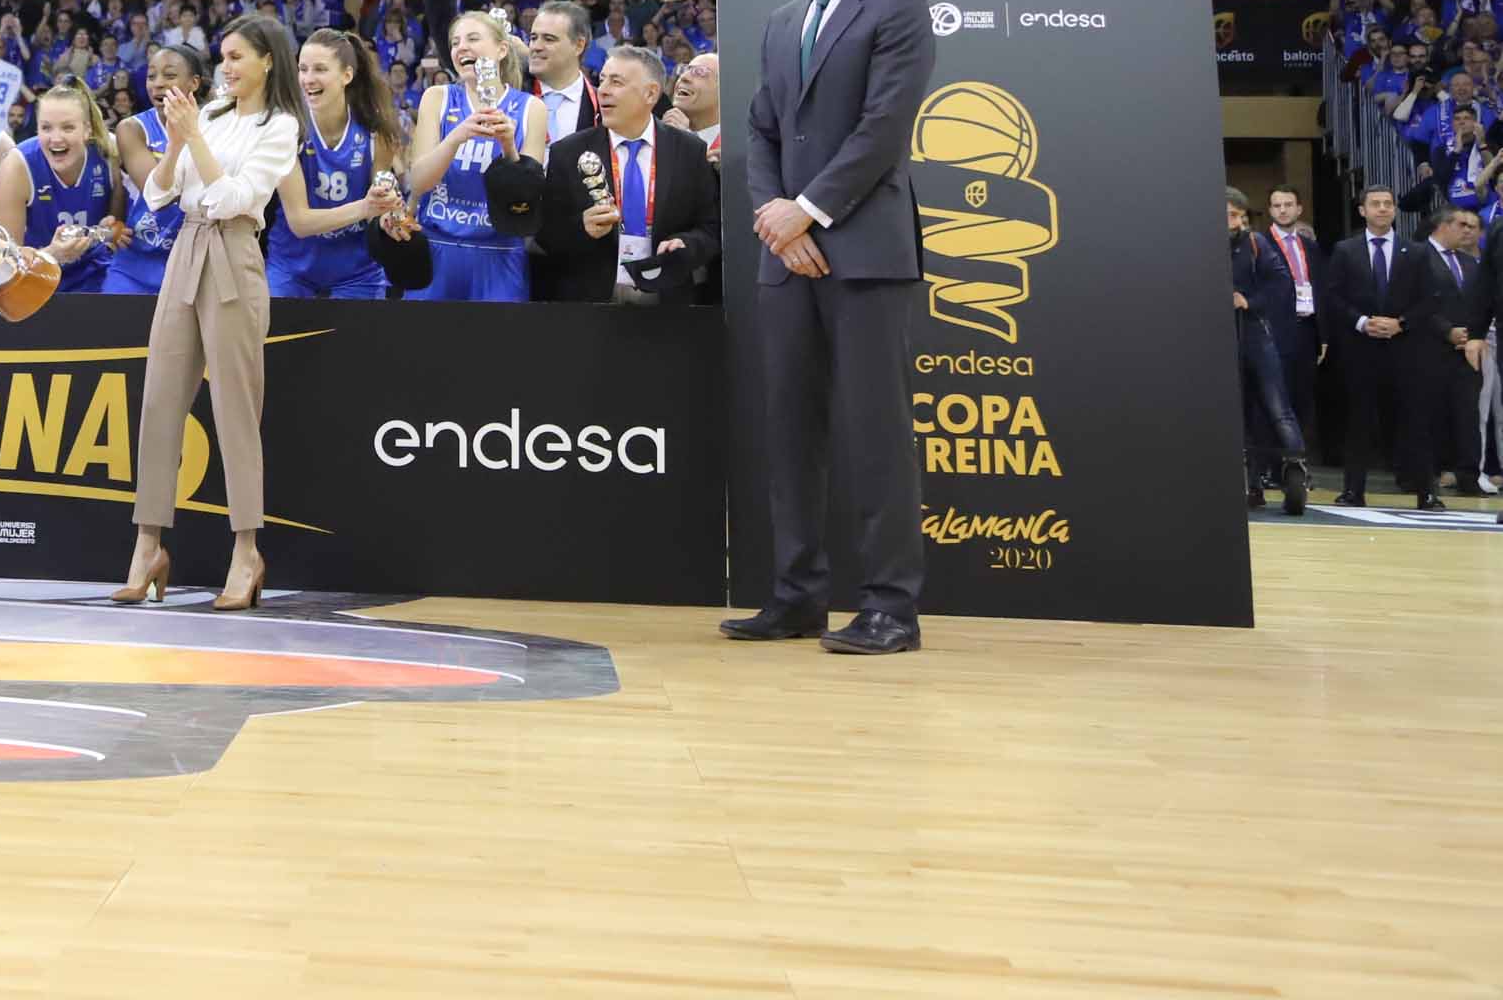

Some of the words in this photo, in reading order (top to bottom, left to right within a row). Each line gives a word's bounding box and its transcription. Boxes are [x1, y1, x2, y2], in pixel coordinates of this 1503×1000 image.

[1019, 9, 1106, 29] endesa
[454, 139, 494, 174] 44
[313, 170, 348, 201] 28
[915, 350, 1033, 376] endesa
[913, 392, 1047, 436] COPA
[374, 408, 665, 474] endesa
[925, 437, 1064, 476] REINA
[0, 529, 35, 538] MUJER
[920, 504, 1071, 544] alamanca
[990, 547, 1052, 568] 2020
